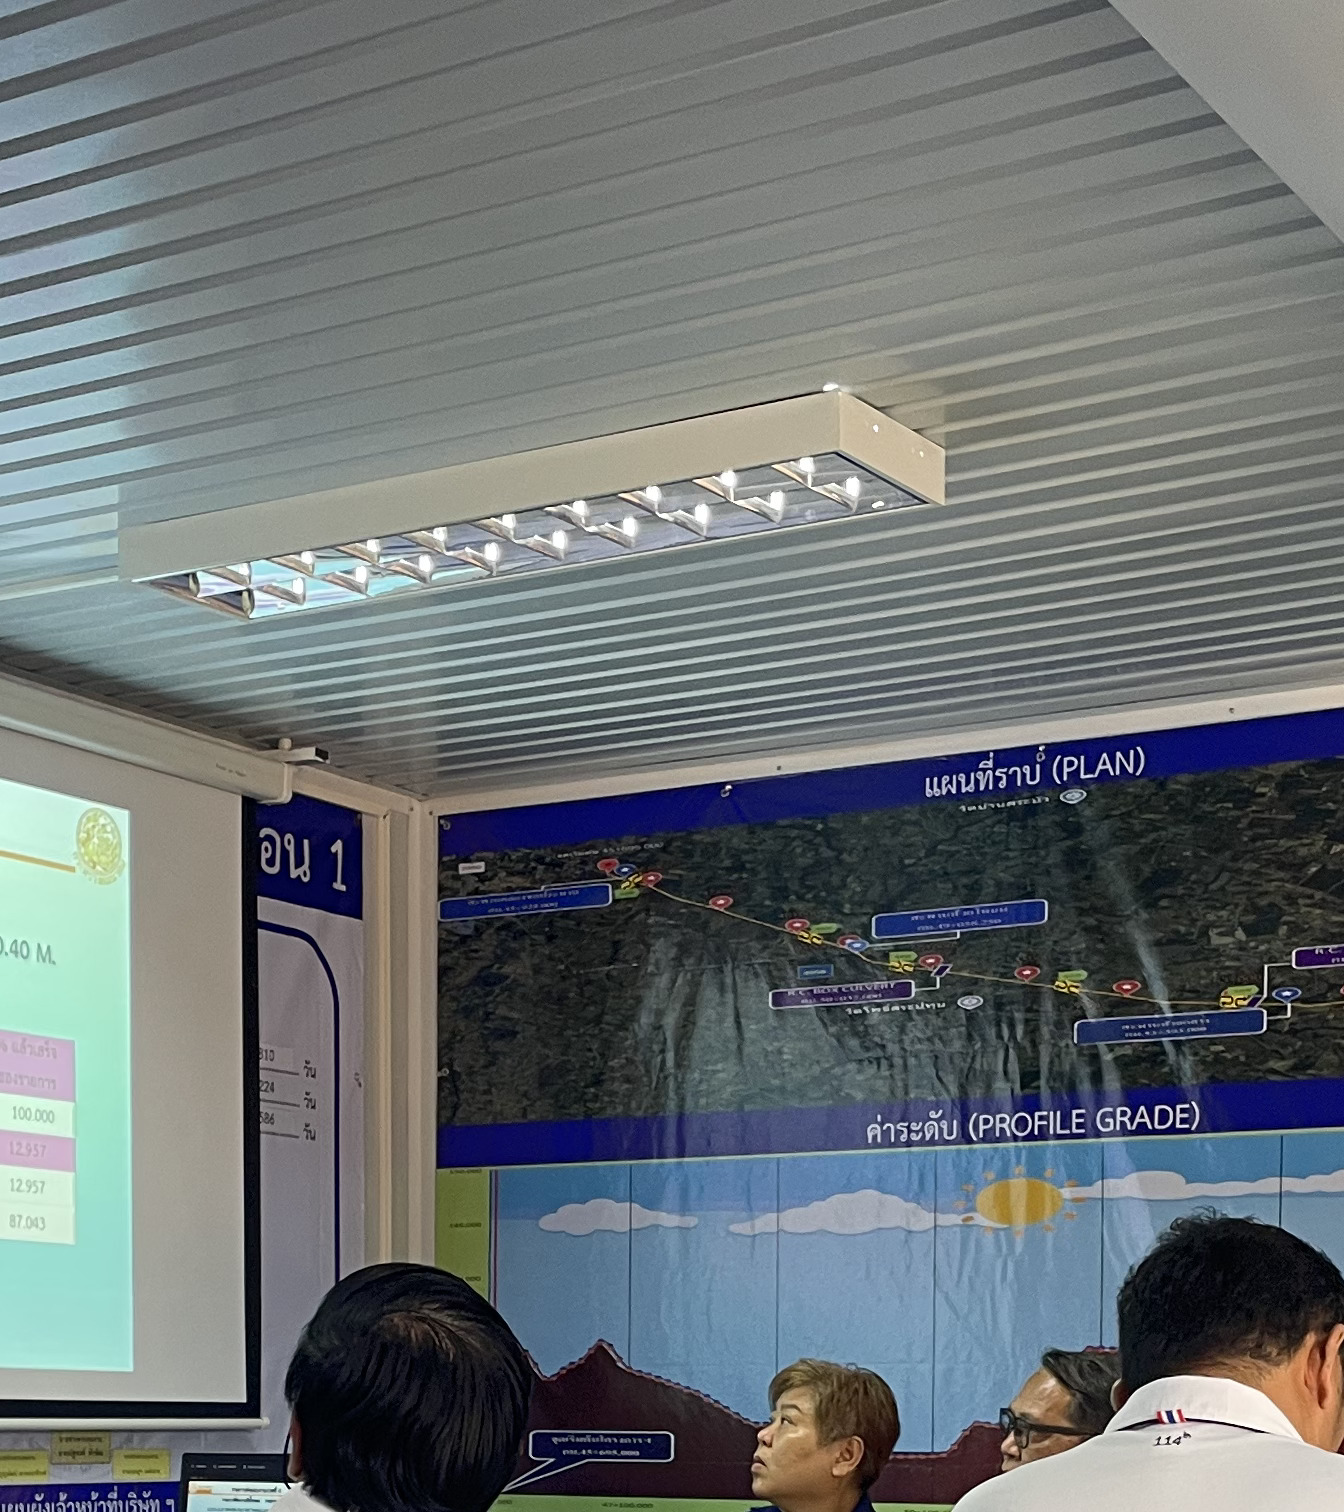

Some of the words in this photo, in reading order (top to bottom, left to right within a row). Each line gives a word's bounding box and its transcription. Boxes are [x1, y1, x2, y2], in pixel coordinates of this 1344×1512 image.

[1052, 747, 1145, 785] (PLAN)
[330, 839, 346, 891] 1
[37, 944, 57, 966] M.
[12, 1106, 55, 1124] 100.000
[866, 1113, 957, 1144] ค่าระดับ
[969, 1110, 1084, 1142] (PROFILE
[1096, 1101, 1200, 1133] GRADE)
[10, 1178, 46, 1194] 12.957
[9, 1214, 46, 1231] 87.043
